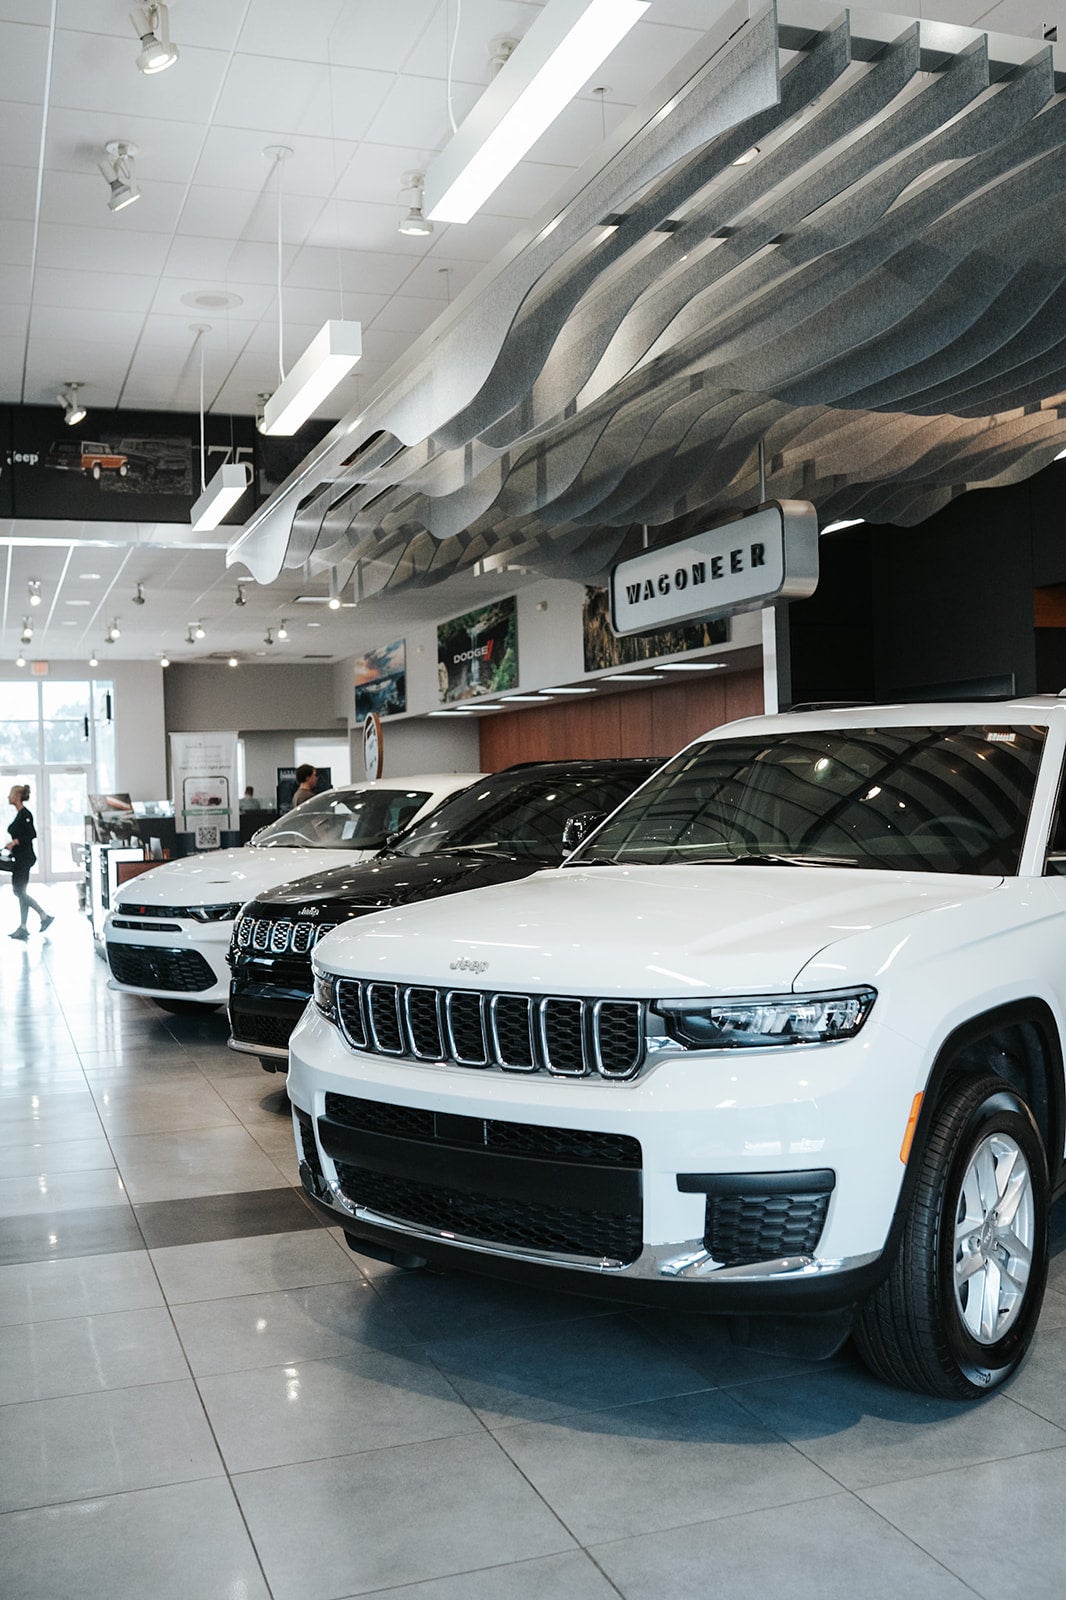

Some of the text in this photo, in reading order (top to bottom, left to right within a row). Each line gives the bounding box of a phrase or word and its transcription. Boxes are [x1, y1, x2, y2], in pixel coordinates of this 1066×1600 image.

[625, 543, 766, 605] WAGONEER
[453, 645, 489, 664] DODGE
[449, 956, 490, 975] Jeep
